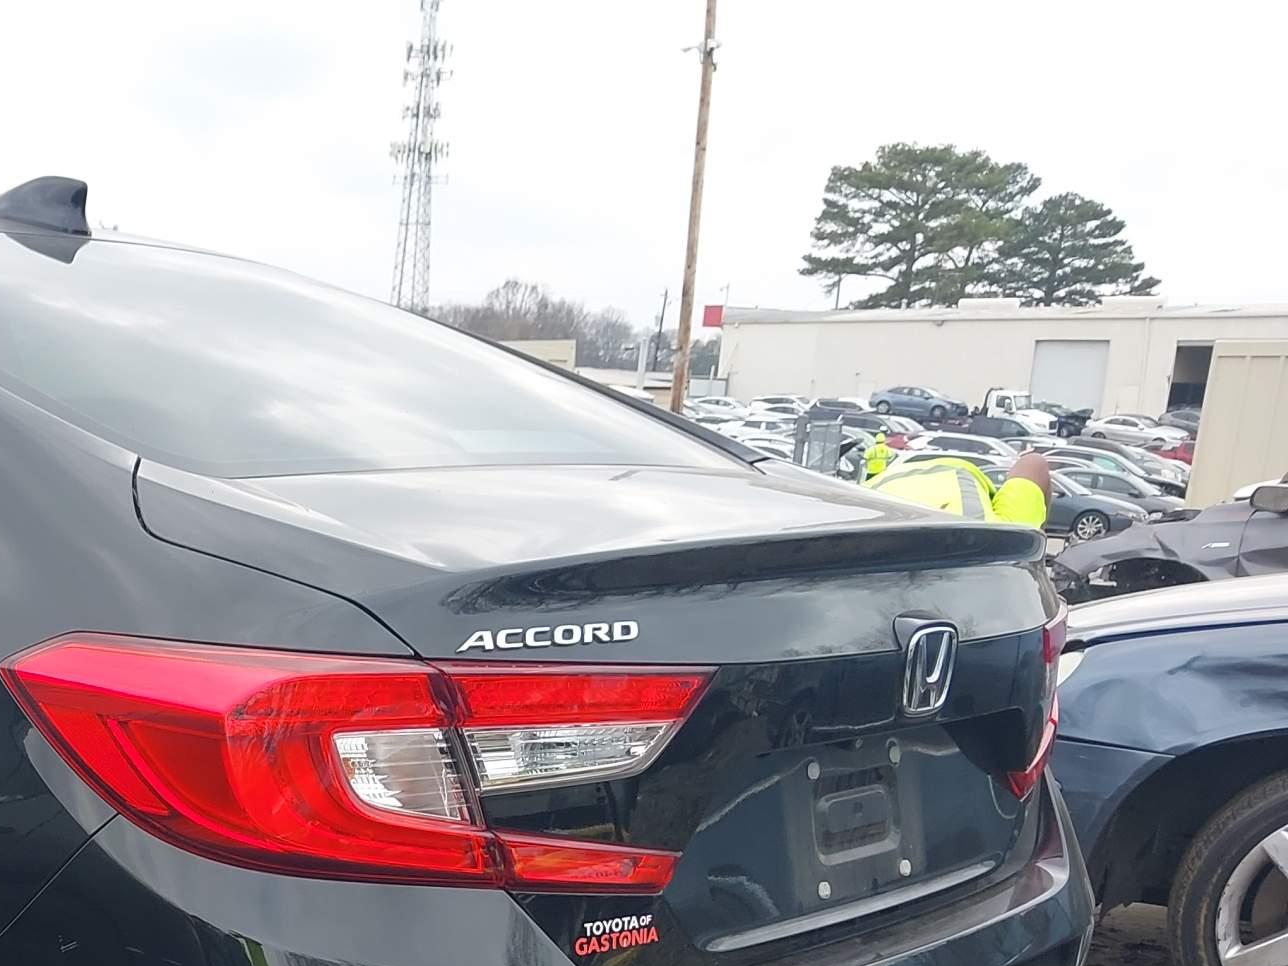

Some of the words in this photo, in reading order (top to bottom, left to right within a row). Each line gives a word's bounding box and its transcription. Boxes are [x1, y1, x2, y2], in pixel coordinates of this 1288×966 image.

[455, 620, 639, 653] ACCORD
[583, 915, 639, 937] TOYOTA
[639, 914, 653, 926] OF
[574, 926, 659, 956] GASTONIA
